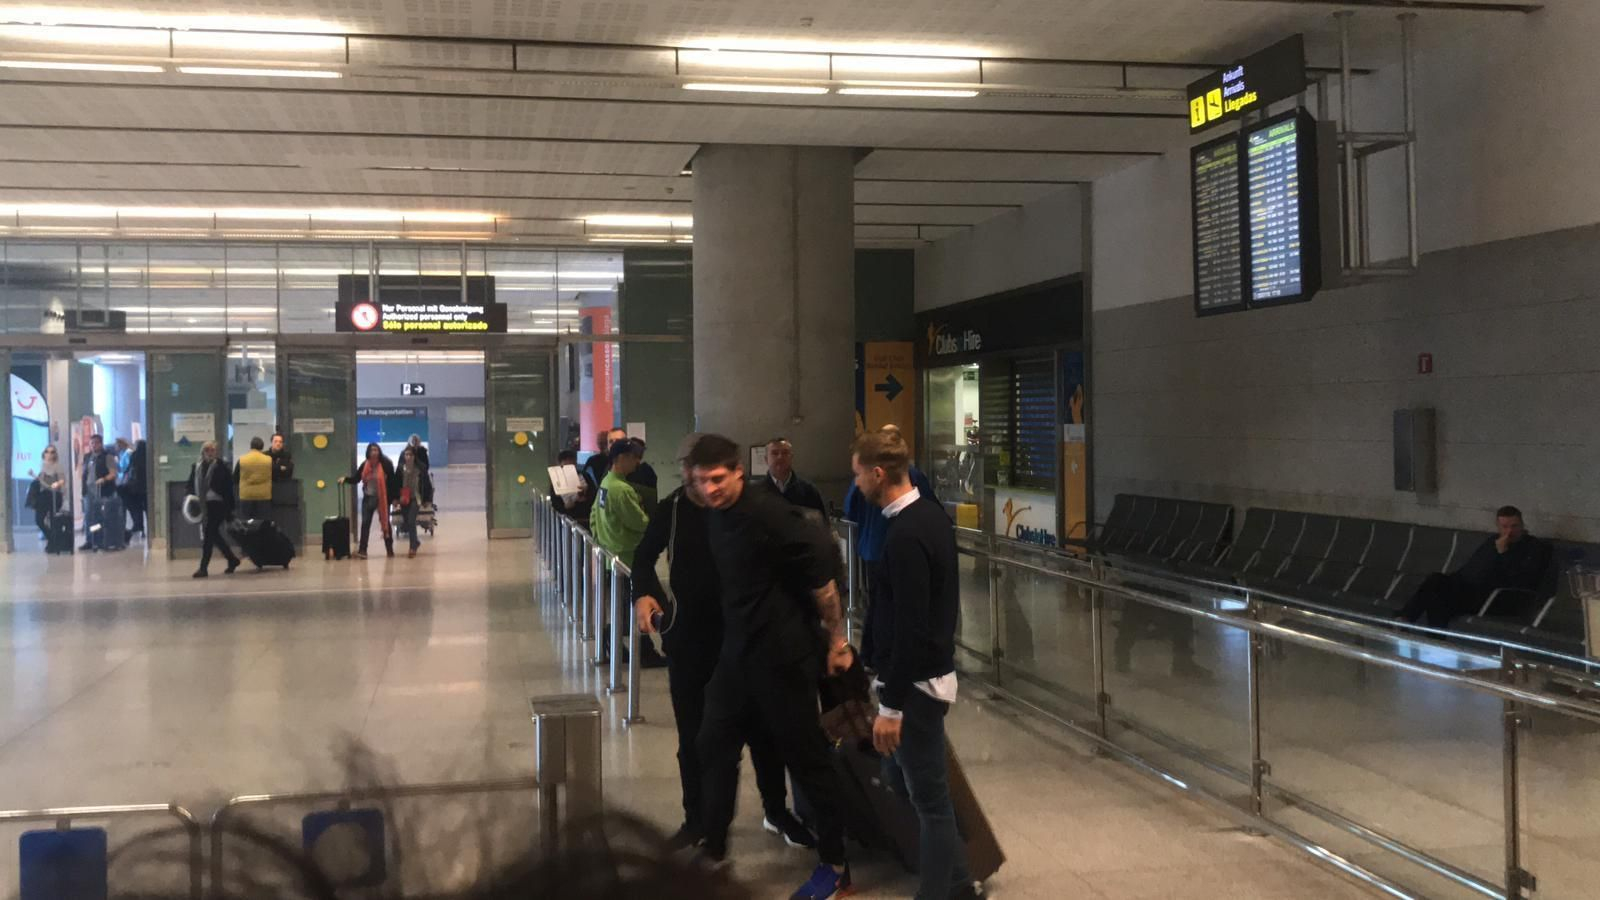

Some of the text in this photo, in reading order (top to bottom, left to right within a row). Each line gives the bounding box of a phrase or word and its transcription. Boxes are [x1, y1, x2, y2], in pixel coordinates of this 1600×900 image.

[1223, 81, 1245, 98] Arrivals
[1225, 91, 1257, 112] Llegadas
[382, 304, 394, 312] Nur
[396, 304, 426, 312] Personal
[427, 304, 438, 312] mit
[453, 313, 468, 322] only
[383, 320, 488, 331] Sólo personal autorizado
[936, 330, 981, 355] Clubs Hire
